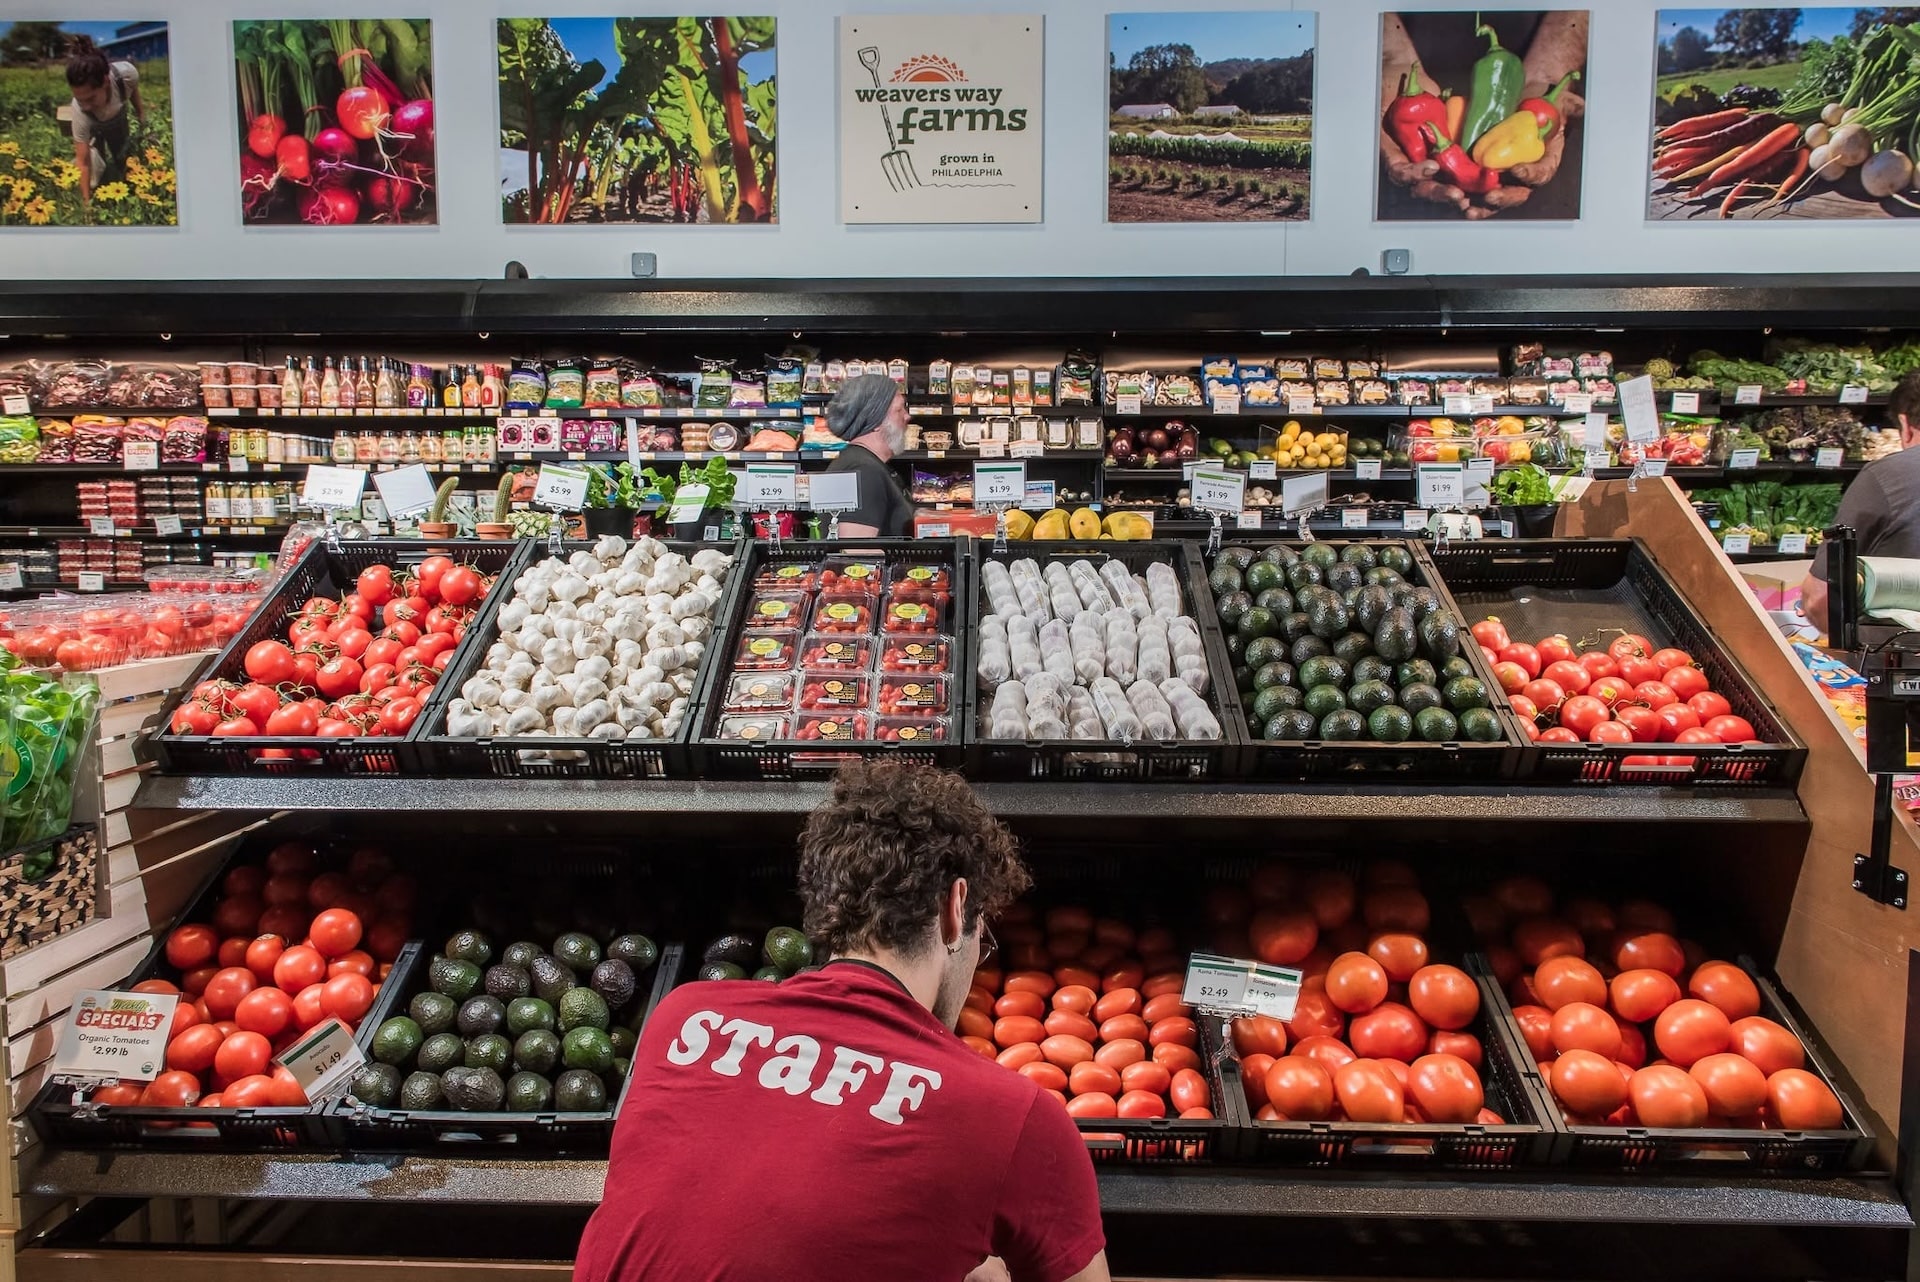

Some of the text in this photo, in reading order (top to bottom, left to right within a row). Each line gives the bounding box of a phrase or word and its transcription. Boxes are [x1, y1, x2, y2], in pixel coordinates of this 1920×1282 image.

[855, 87, 1003, 106] weavers way
[896, 106, 1028, 145] farms
[940, 152, 995, 166] grown in
[932, 168, 1003, 177] PHILADELPHIA
[321, 487, 344, 495] $2.99
[550, 485, 571, 496] $5.99
[760, 487, 782, 496] $2.99
[989, 485, 1011, 494] $1.99
[1432, 483, 1451, 493] $1.99
[1207, 490, 1228, 500] $1.99
[16, 745, 31, 761] LLC
[1199, 986, 1229, 998] $2.49
[80, 1011, 158, 1029] SPECIALS
[78, 1033, 150, 1045] Organic Tomatoes
[92, 1046, 129, 1056] $2.99 lb
[315, 1051, 341, 1076] $1.49
